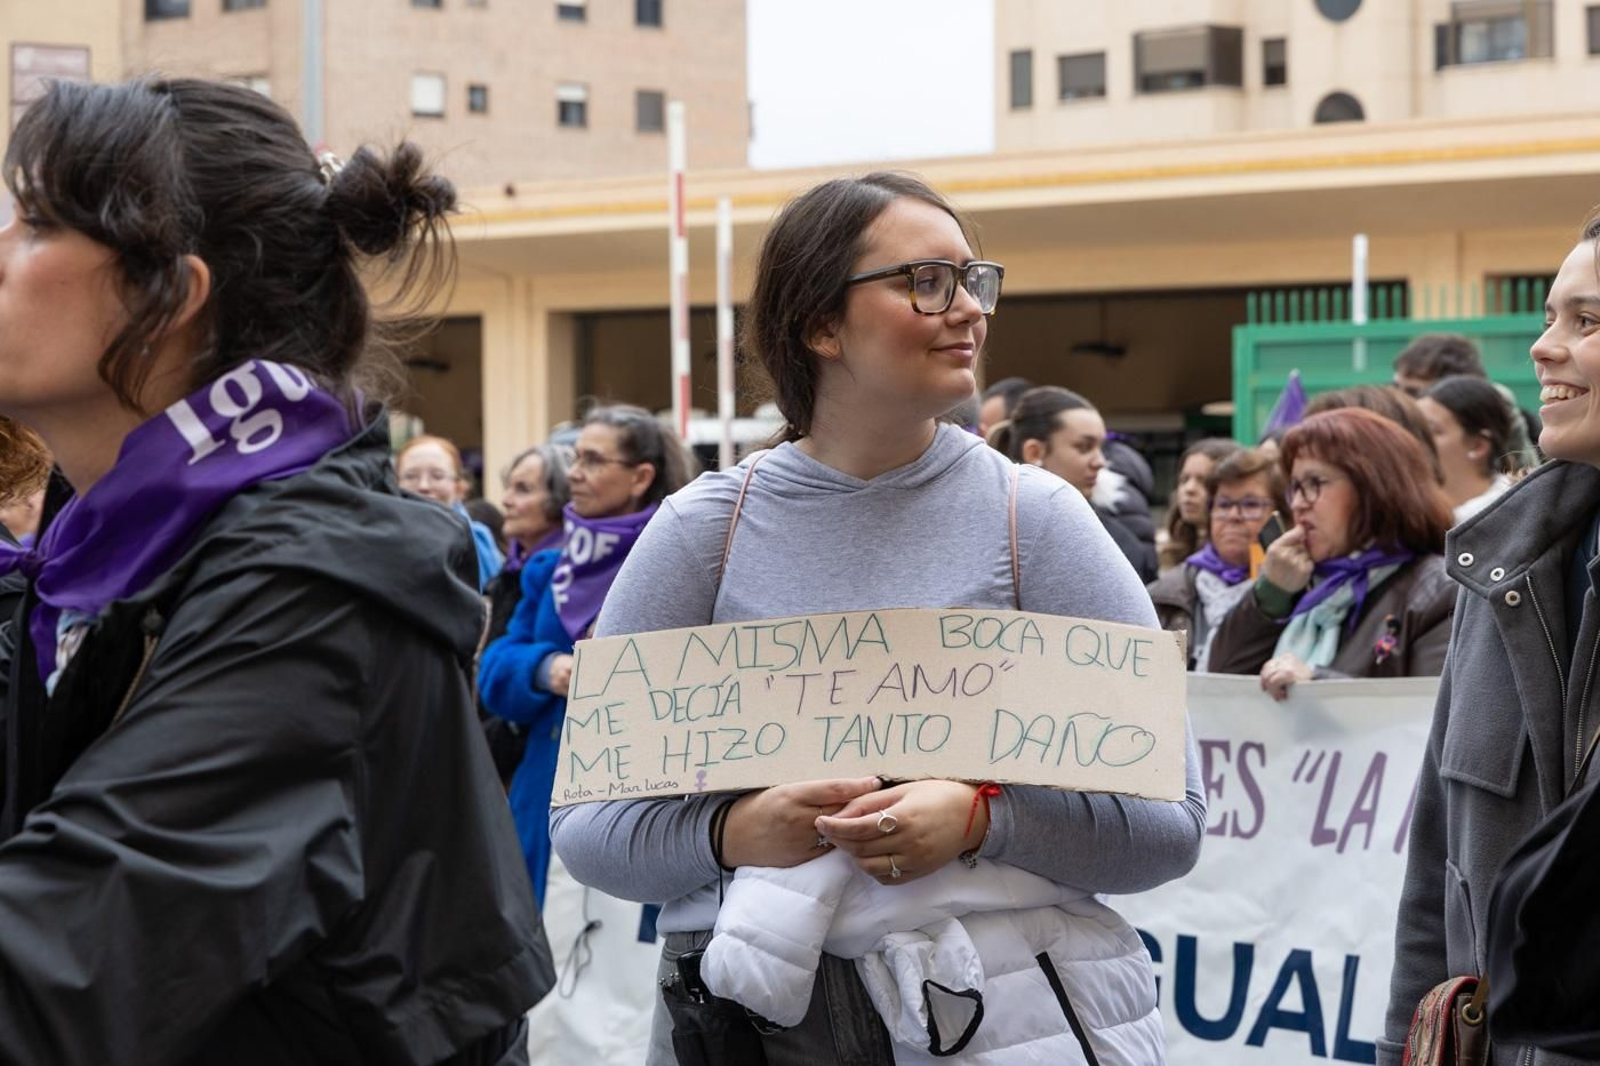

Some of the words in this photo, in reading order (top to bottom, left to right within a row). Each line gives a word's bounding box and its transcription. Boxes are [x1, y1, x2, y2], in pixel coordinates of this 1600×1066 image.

[573, 638, 651, 700] LA
[676, 612, 889, 681] MISMA
[940, 614, 1044, 655] BOCA
[1065, 624, 1153, 677] QUE
[566, 702, 625, 746] ME
[649, 674, 741, 724] DECÍA
[570, 745, 631, 783] ME
[663, 722, 786, 775] HIZO
[813, 714, 951, 763] TANTO
[988, 708, 1156, 768] DAÑO
[563, 784, 593, 801] Rota
